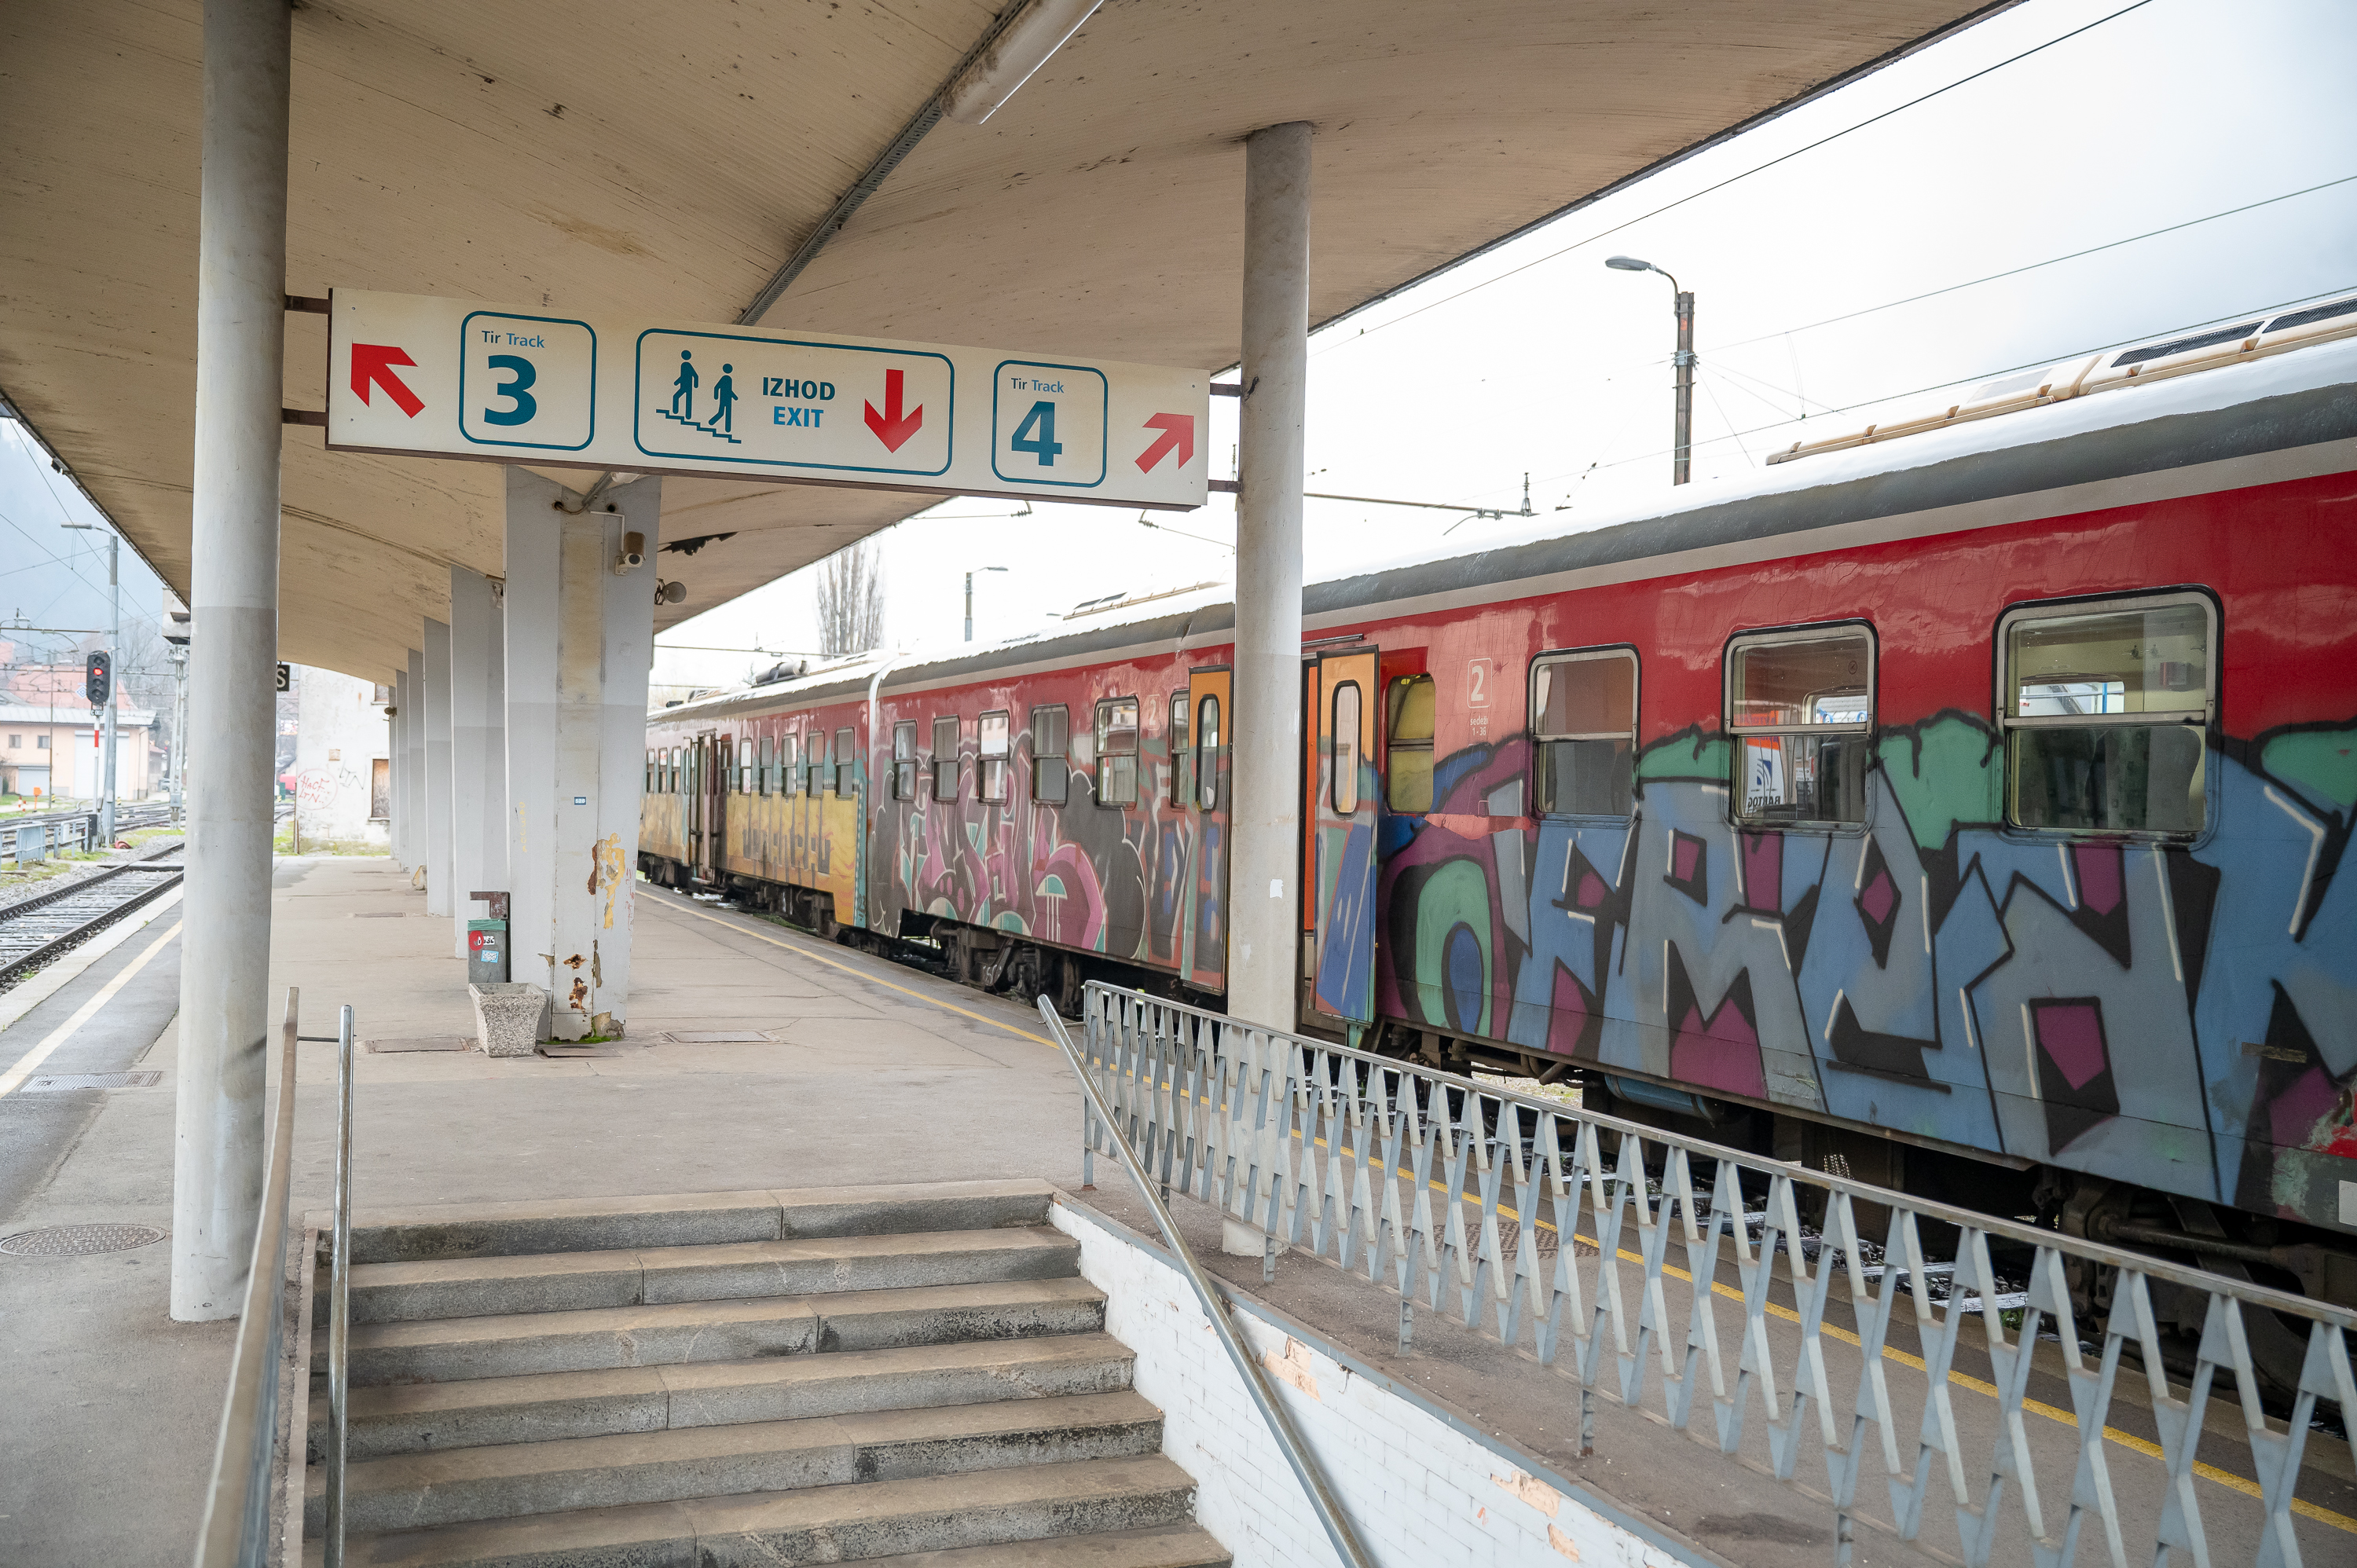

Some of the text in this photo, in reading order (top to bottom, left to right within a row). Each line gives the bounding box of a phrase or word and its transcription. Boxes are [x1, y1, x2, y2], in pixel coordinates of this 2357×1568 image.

[481, 330, 545, 349] Tir Track
[483, 354, 537, 427] 3
[762, 376, 836, 401] IZHOD
[1010, 378, 1065, 394] Tir Track
[773, 405, 824, 428] EXIT
[1011, 401, 1062, 467] 4
[1471, 665, 1484, 702] 2
[1149, 698, 1157, 726] 2
